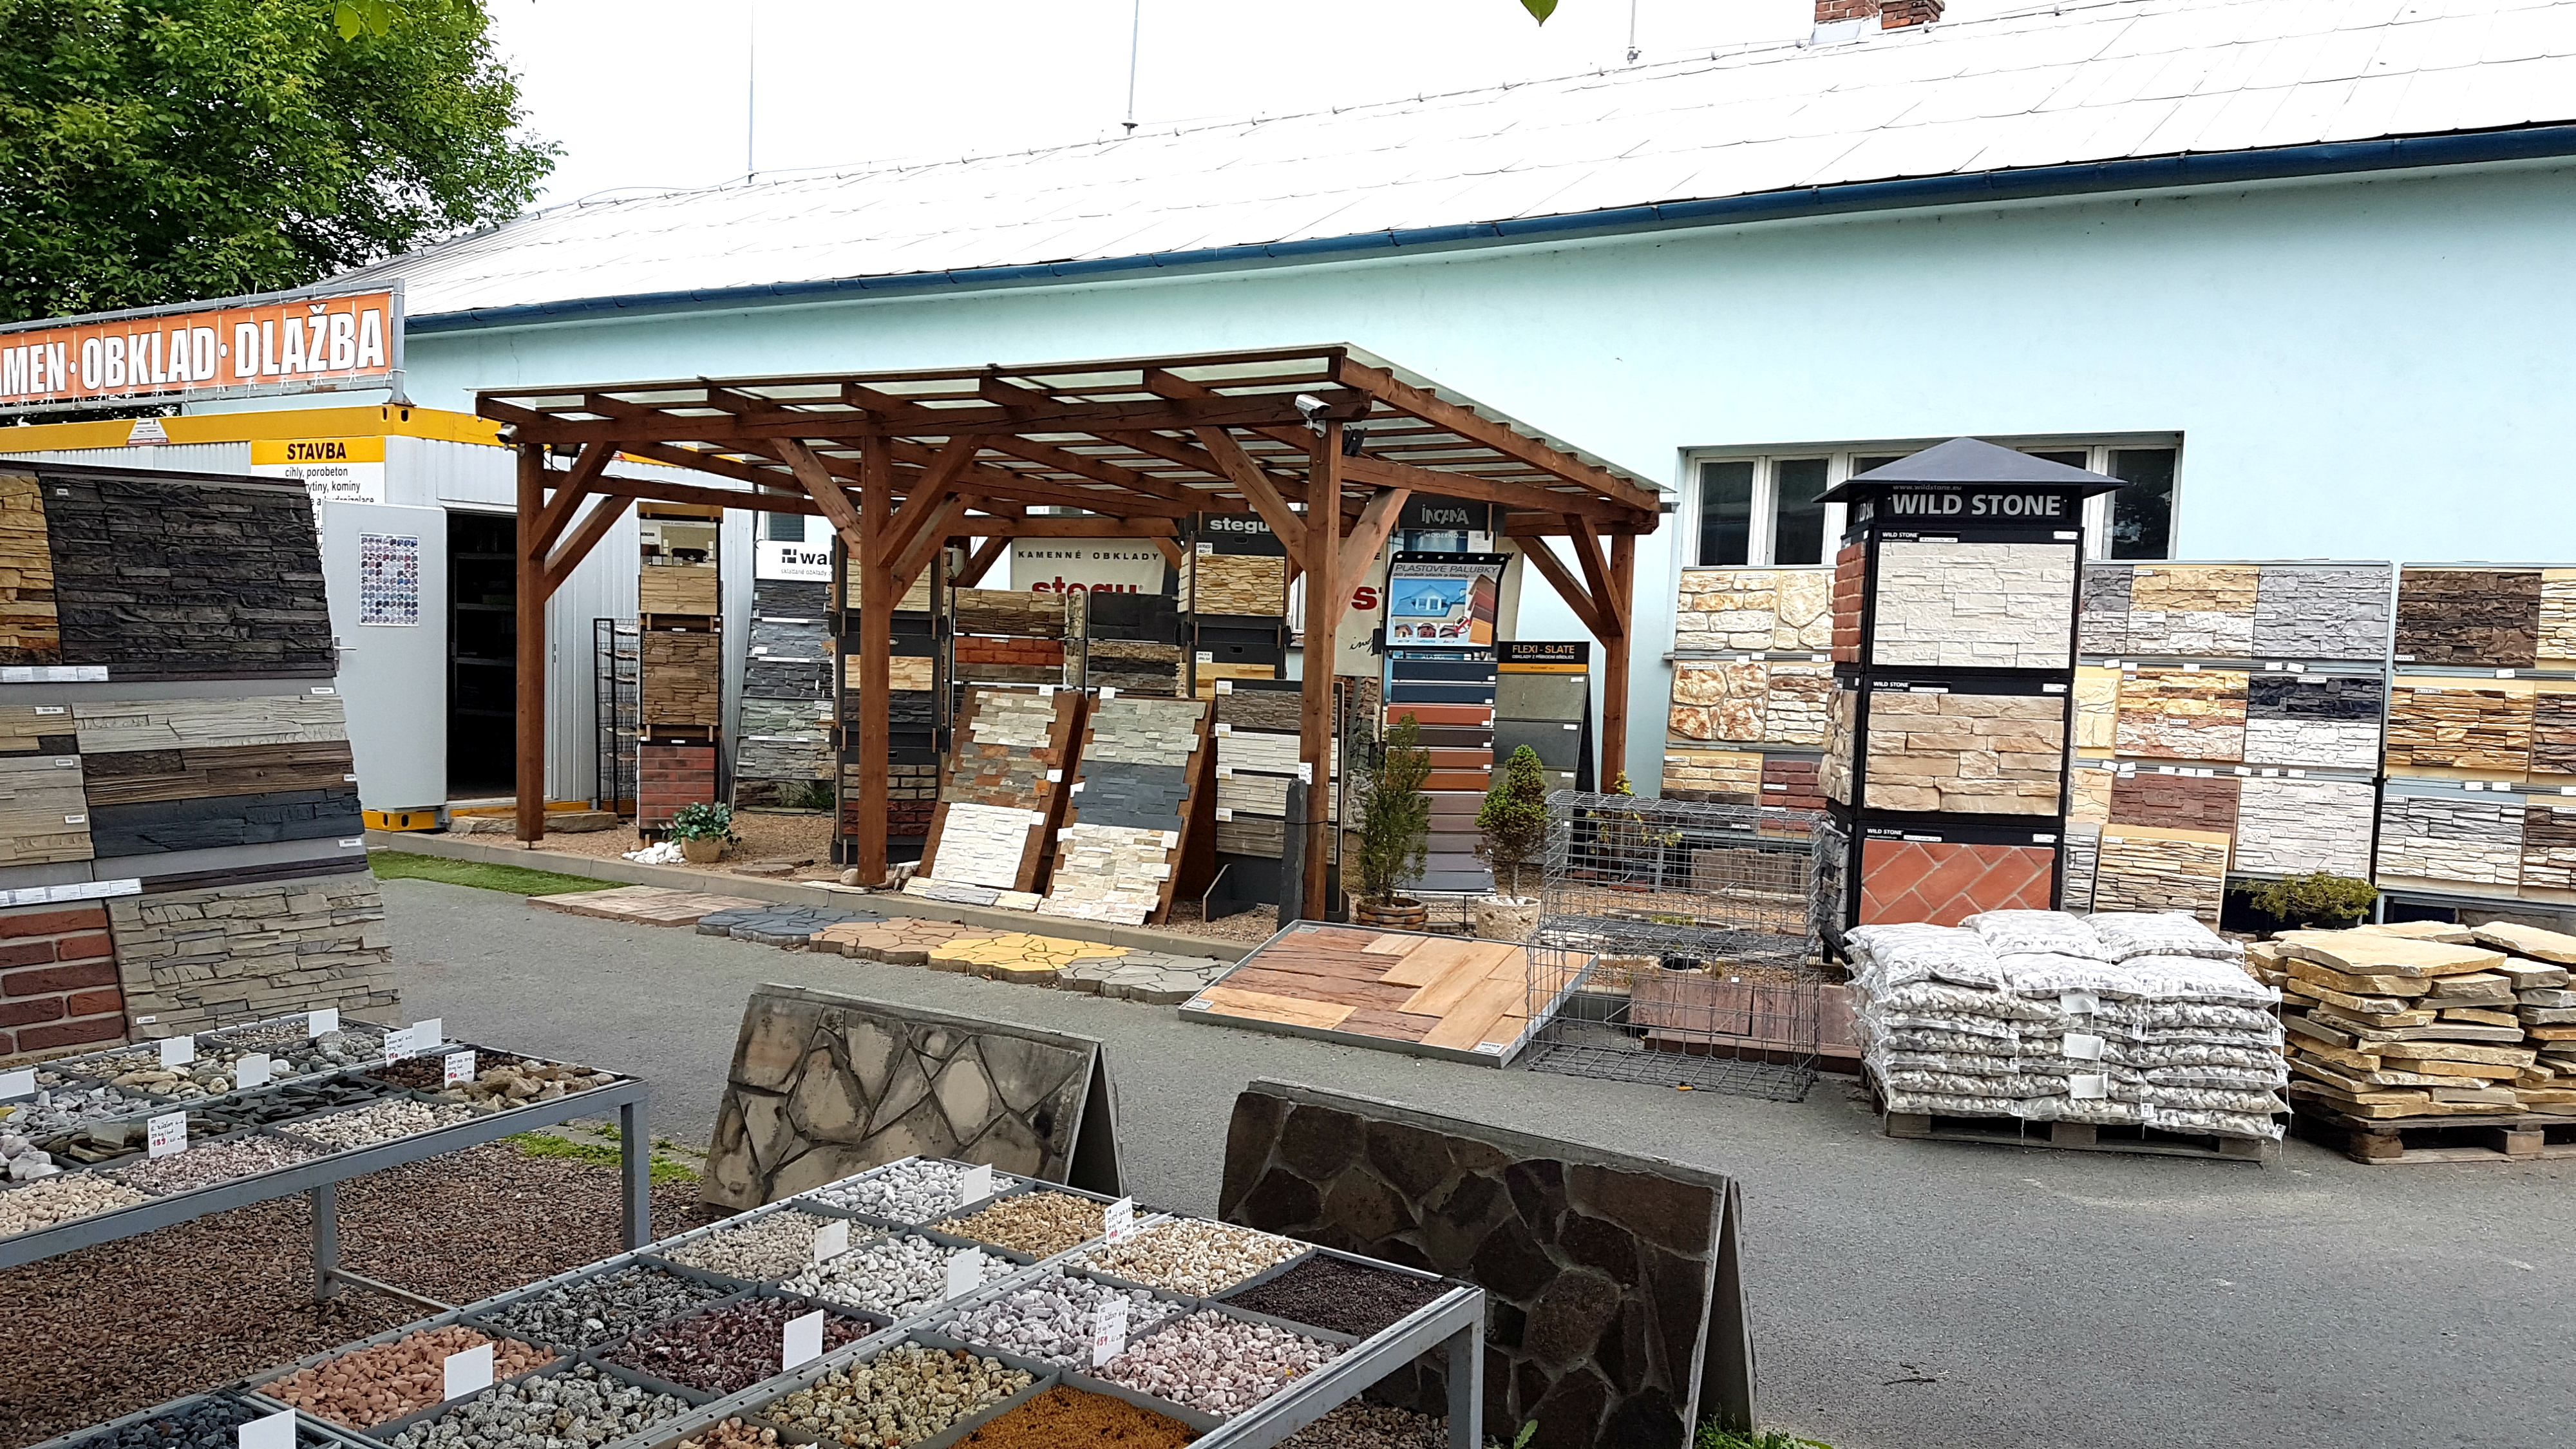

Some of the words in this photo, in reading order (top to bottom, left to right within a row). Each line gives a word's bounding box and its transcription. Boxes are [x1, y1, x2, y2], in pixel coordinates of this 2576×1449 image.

[0, 341, 65, 397] MEN
[81, 327, 216, 390] OBKLAD
[234, 303, 385, 378] DLAŽBA
[287, 442, 347, 460] STAVBA
[307, 466, 348, 478] porobeton
[305, 480, 329, 494] rytiny,
[332, 480, 361, 493] komíny
[1892, 494, 1962, 514] WILD
[1971, 494, 2061, 516] STONE
[1209, 517, 1271, 534] stegu
[1018, 550, 1082, 559] KAMENNÉ
[1092, 552, 1159, 560] OBKLADY
[1395, 564, 1446, 573] PLASTOVÉ
[1450, 565, 1499, 574] PALUBKY
[1512, 645, 1538, 653] FLEXI
[1544, 645, 1575, 654] SLATE
